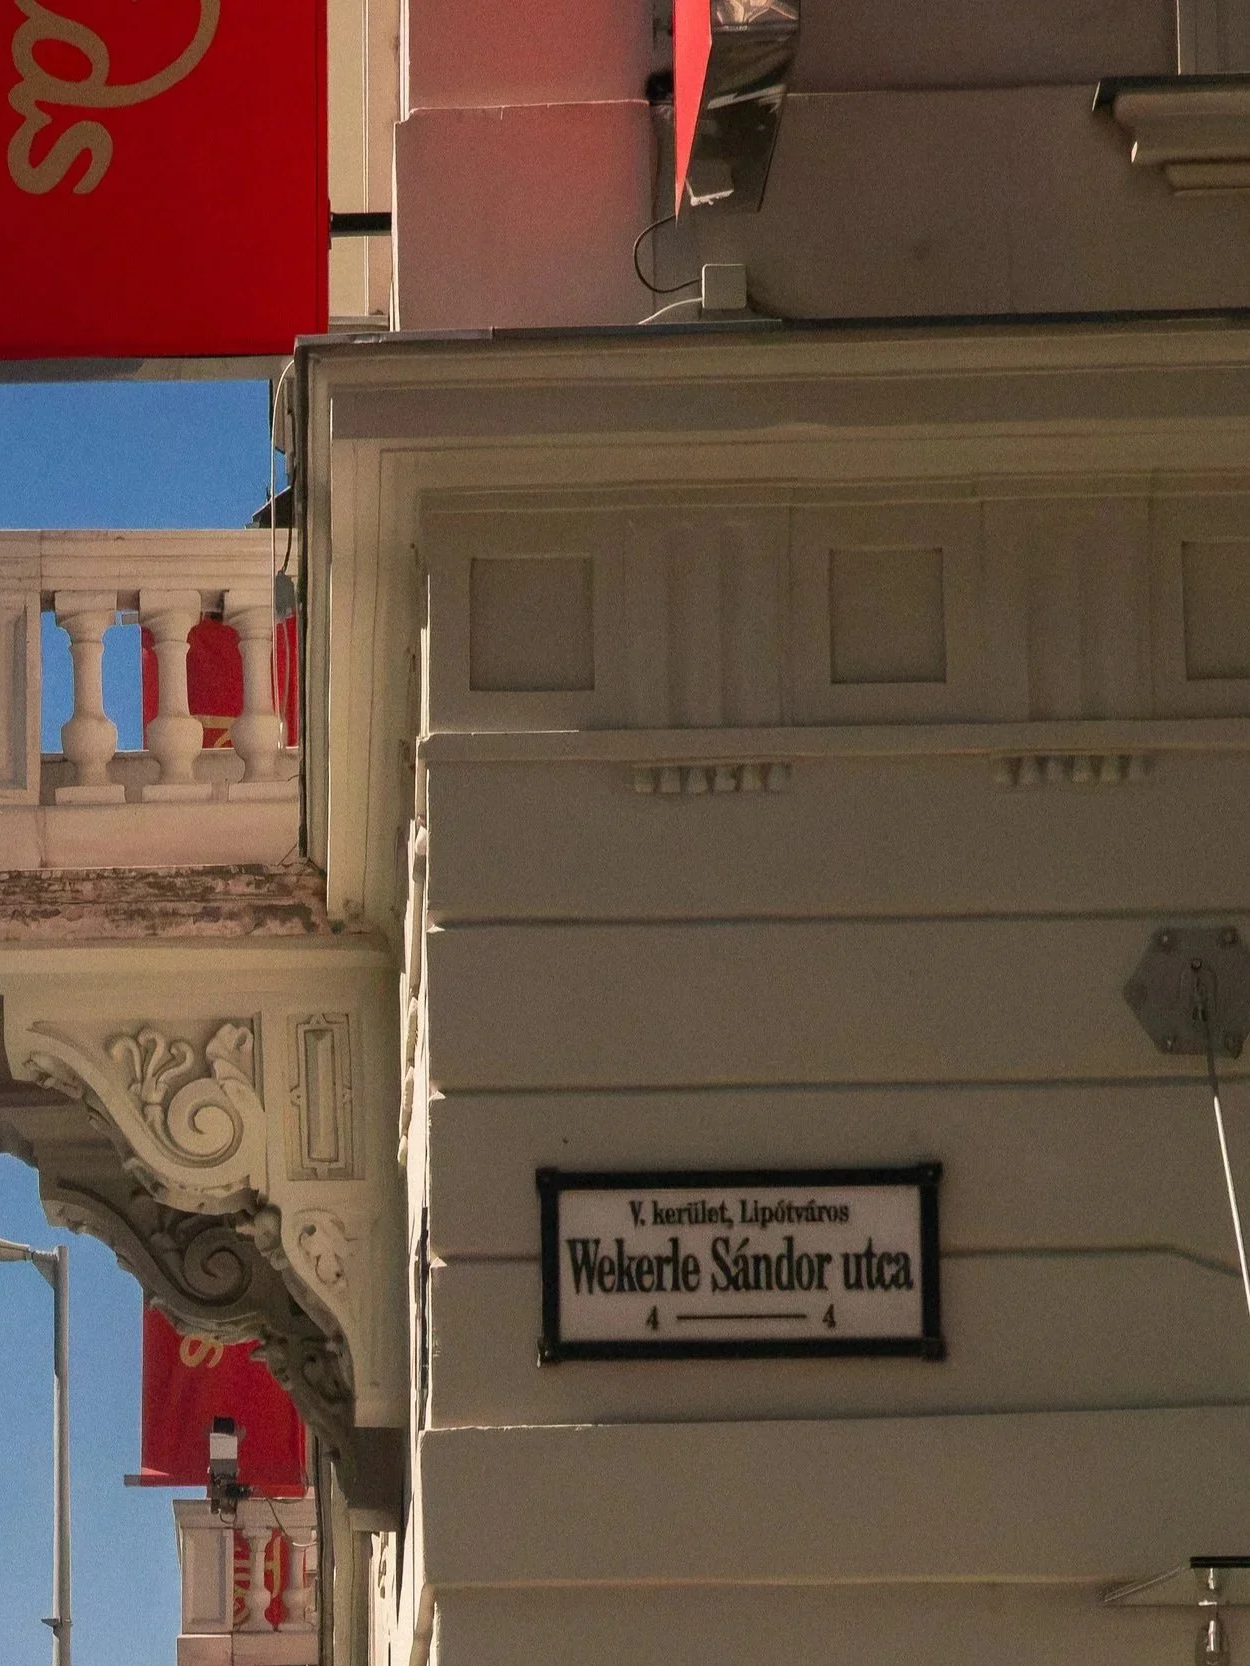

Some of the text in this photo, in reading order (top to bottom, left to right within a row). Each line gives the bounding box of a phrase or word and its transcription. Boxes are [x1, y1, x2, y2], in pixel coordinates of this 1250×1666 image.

[630, 1199, 849, 1229] V. kerület, Lipótváros
[566, 1235, 914, 1296] Wekerle Sándor utca
[646, 1304, 836, 1330] 4 4
